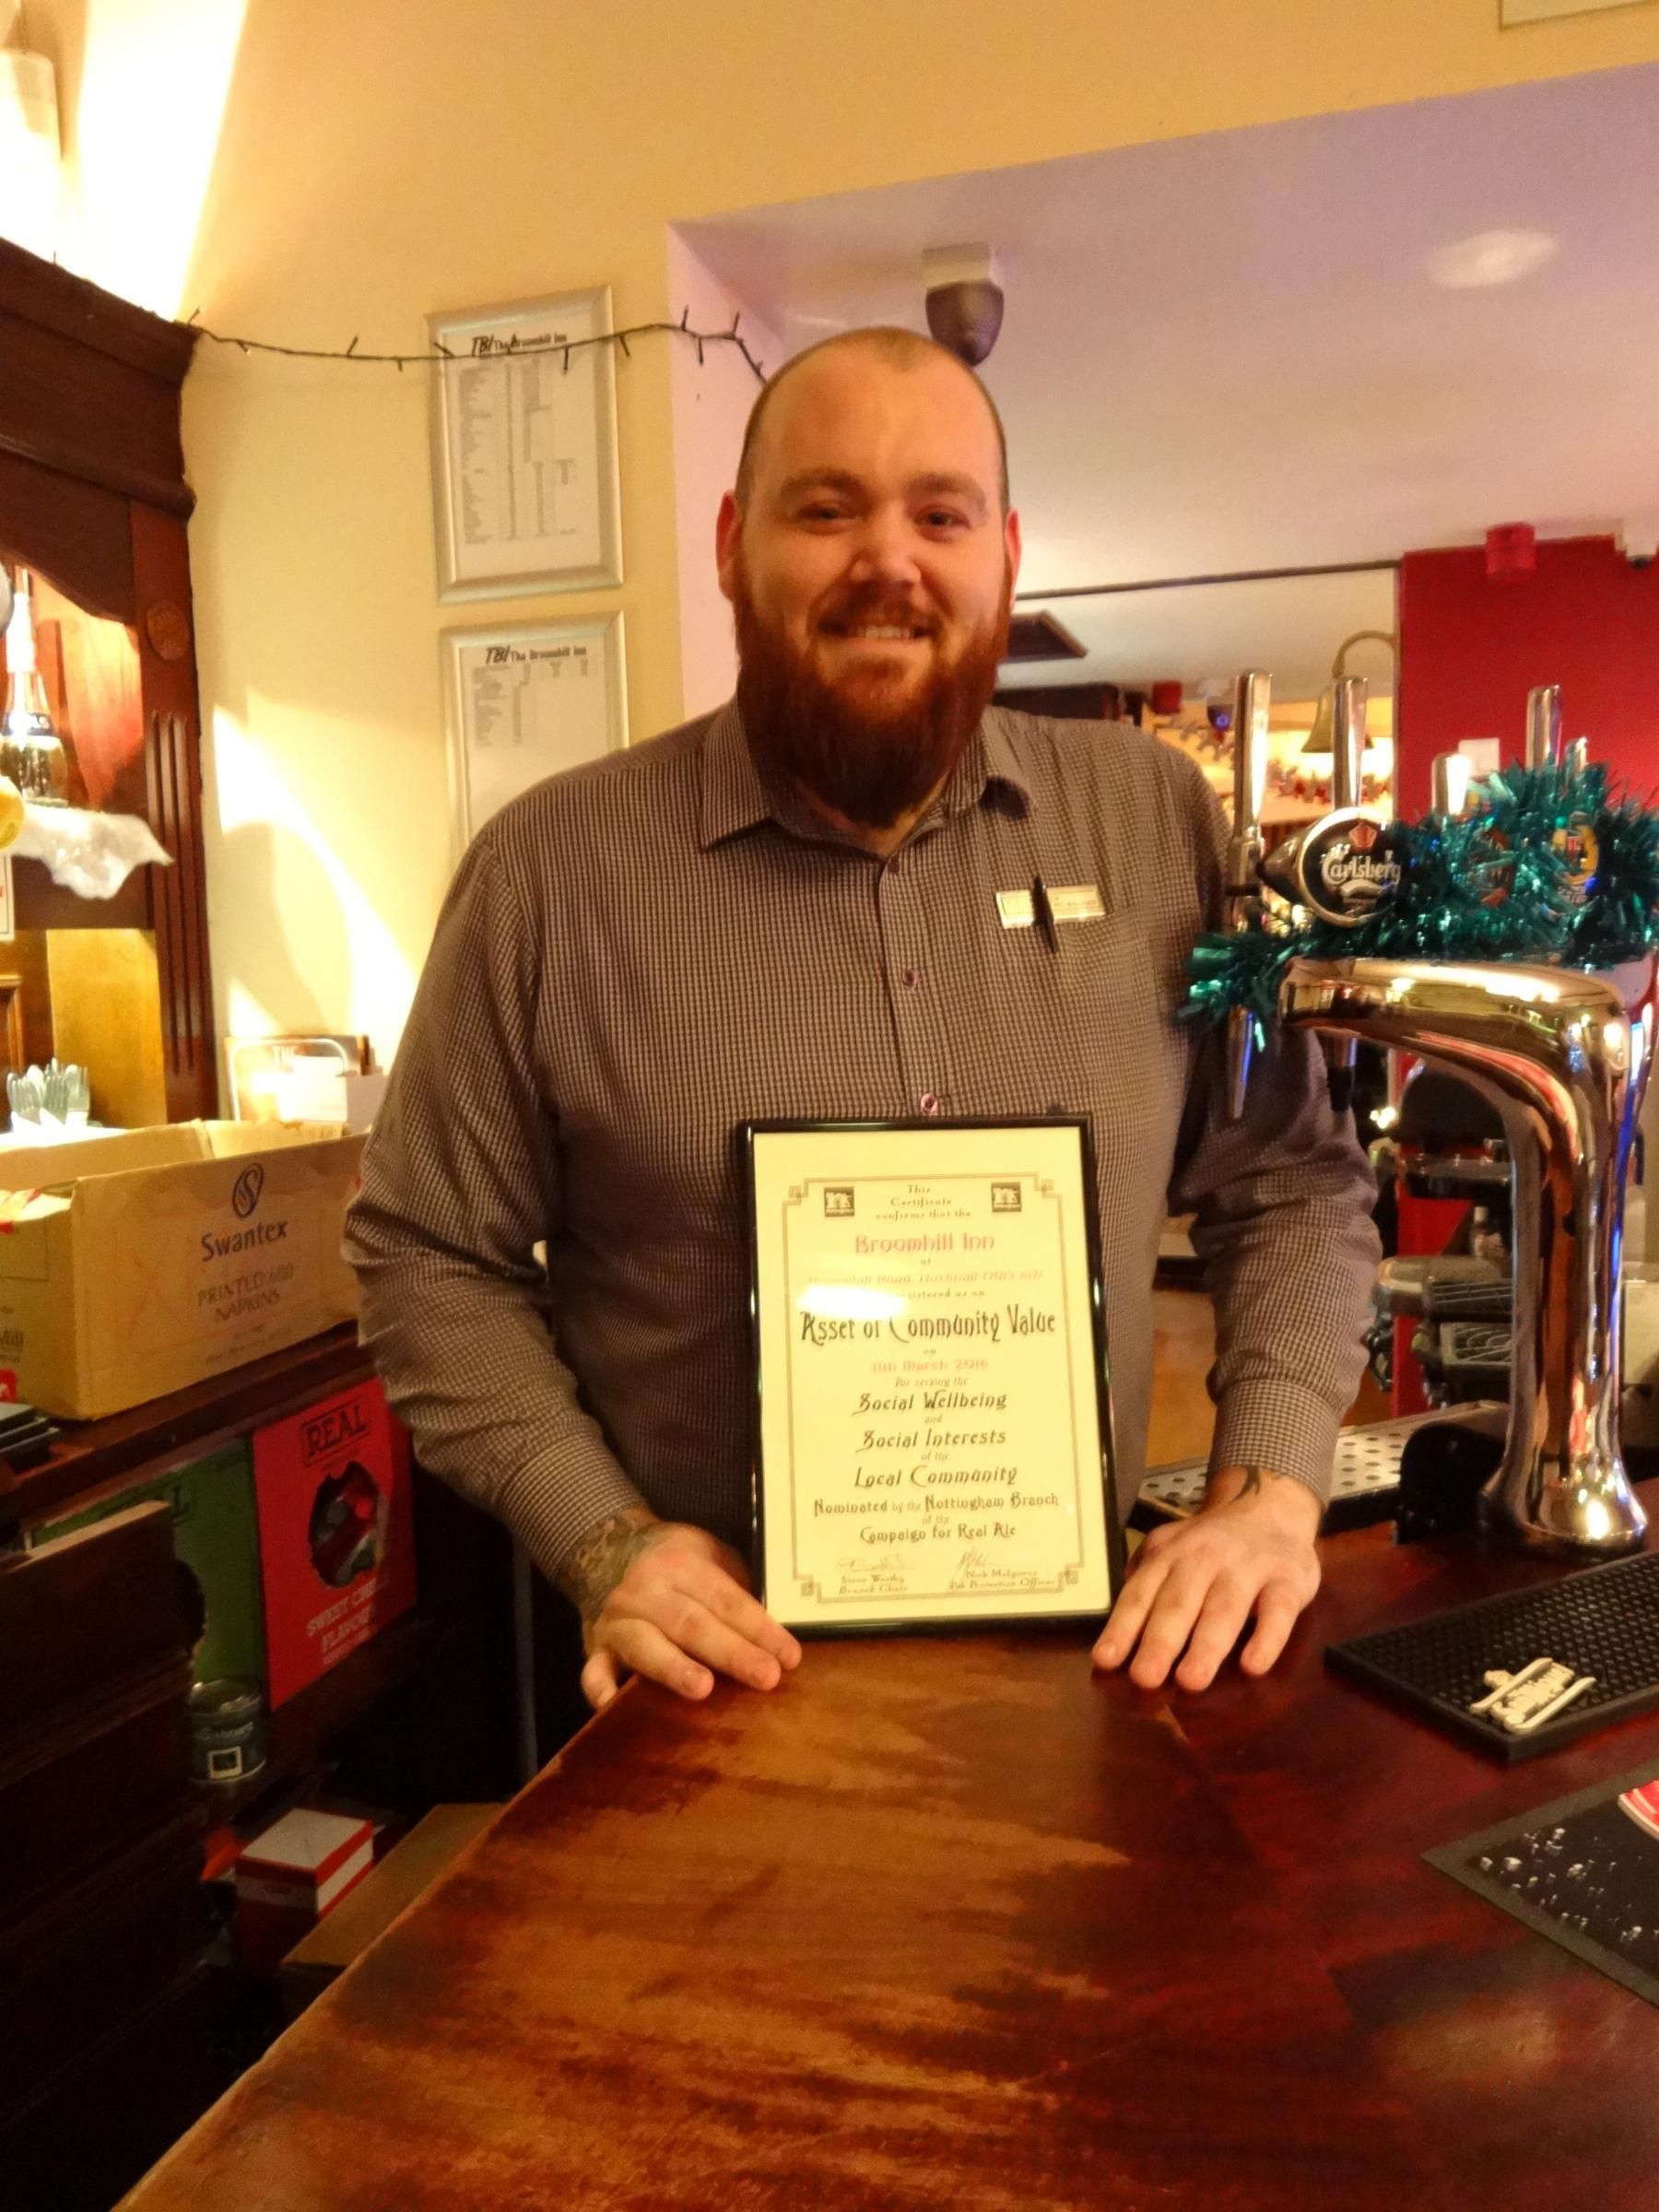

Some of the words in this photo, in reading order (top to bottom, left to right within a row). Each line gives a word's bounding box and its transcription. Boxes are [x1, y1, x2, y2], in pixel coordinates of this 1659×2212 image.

[1322, 844, 1401, 891] Carlsberg
[907, 1183, 931, 1194] This
[890, 1196, 952, 1208] Certificate
[876, 1210, 924, 1221] confirms
[929, 1209, 950, 1219] that
[954, 1208, 971, 1218] the
[200, 1219, 288, 1263] Swantex
[854, 1231, 954, 1254] Broomhill
[962, 1231, 995, 1253] Inn
[799, 1310, 856, 1347] Asset
[888, 1310, 1002, 1345] Community
[1006, 1302, 1056, 1336] Value
[902, 1359, 948, 1372] March
[954, 1359, 989, 1371] 2016
[953, 1375, 969, 1386] the
[850, 1393, 915, 1417] Social
[924, 1389, 1008, 1412] Wellbeing
[305, 1404, 368, 1457] REAL
[924, 1414, 944, 1425] and
[855, 1429, 920, 1453] Social
[925, 1428, 1007, 1449] Interests
[853, 1465, 903, 1489] Local
[910, 1465, 1018, 1488] Community
[813, 1497, 888, 1518] Nominated
[924, 1493, 1005, 1512] Nottingham
[1010, 1490, 1059, 1508] Branch
[860, 1525, 927, 1547] Campaign
[932, 1525, 952, 1540] for
[958, 1523, 987, 1541] Real
[993, 1521, 1018, 1538] Ale
